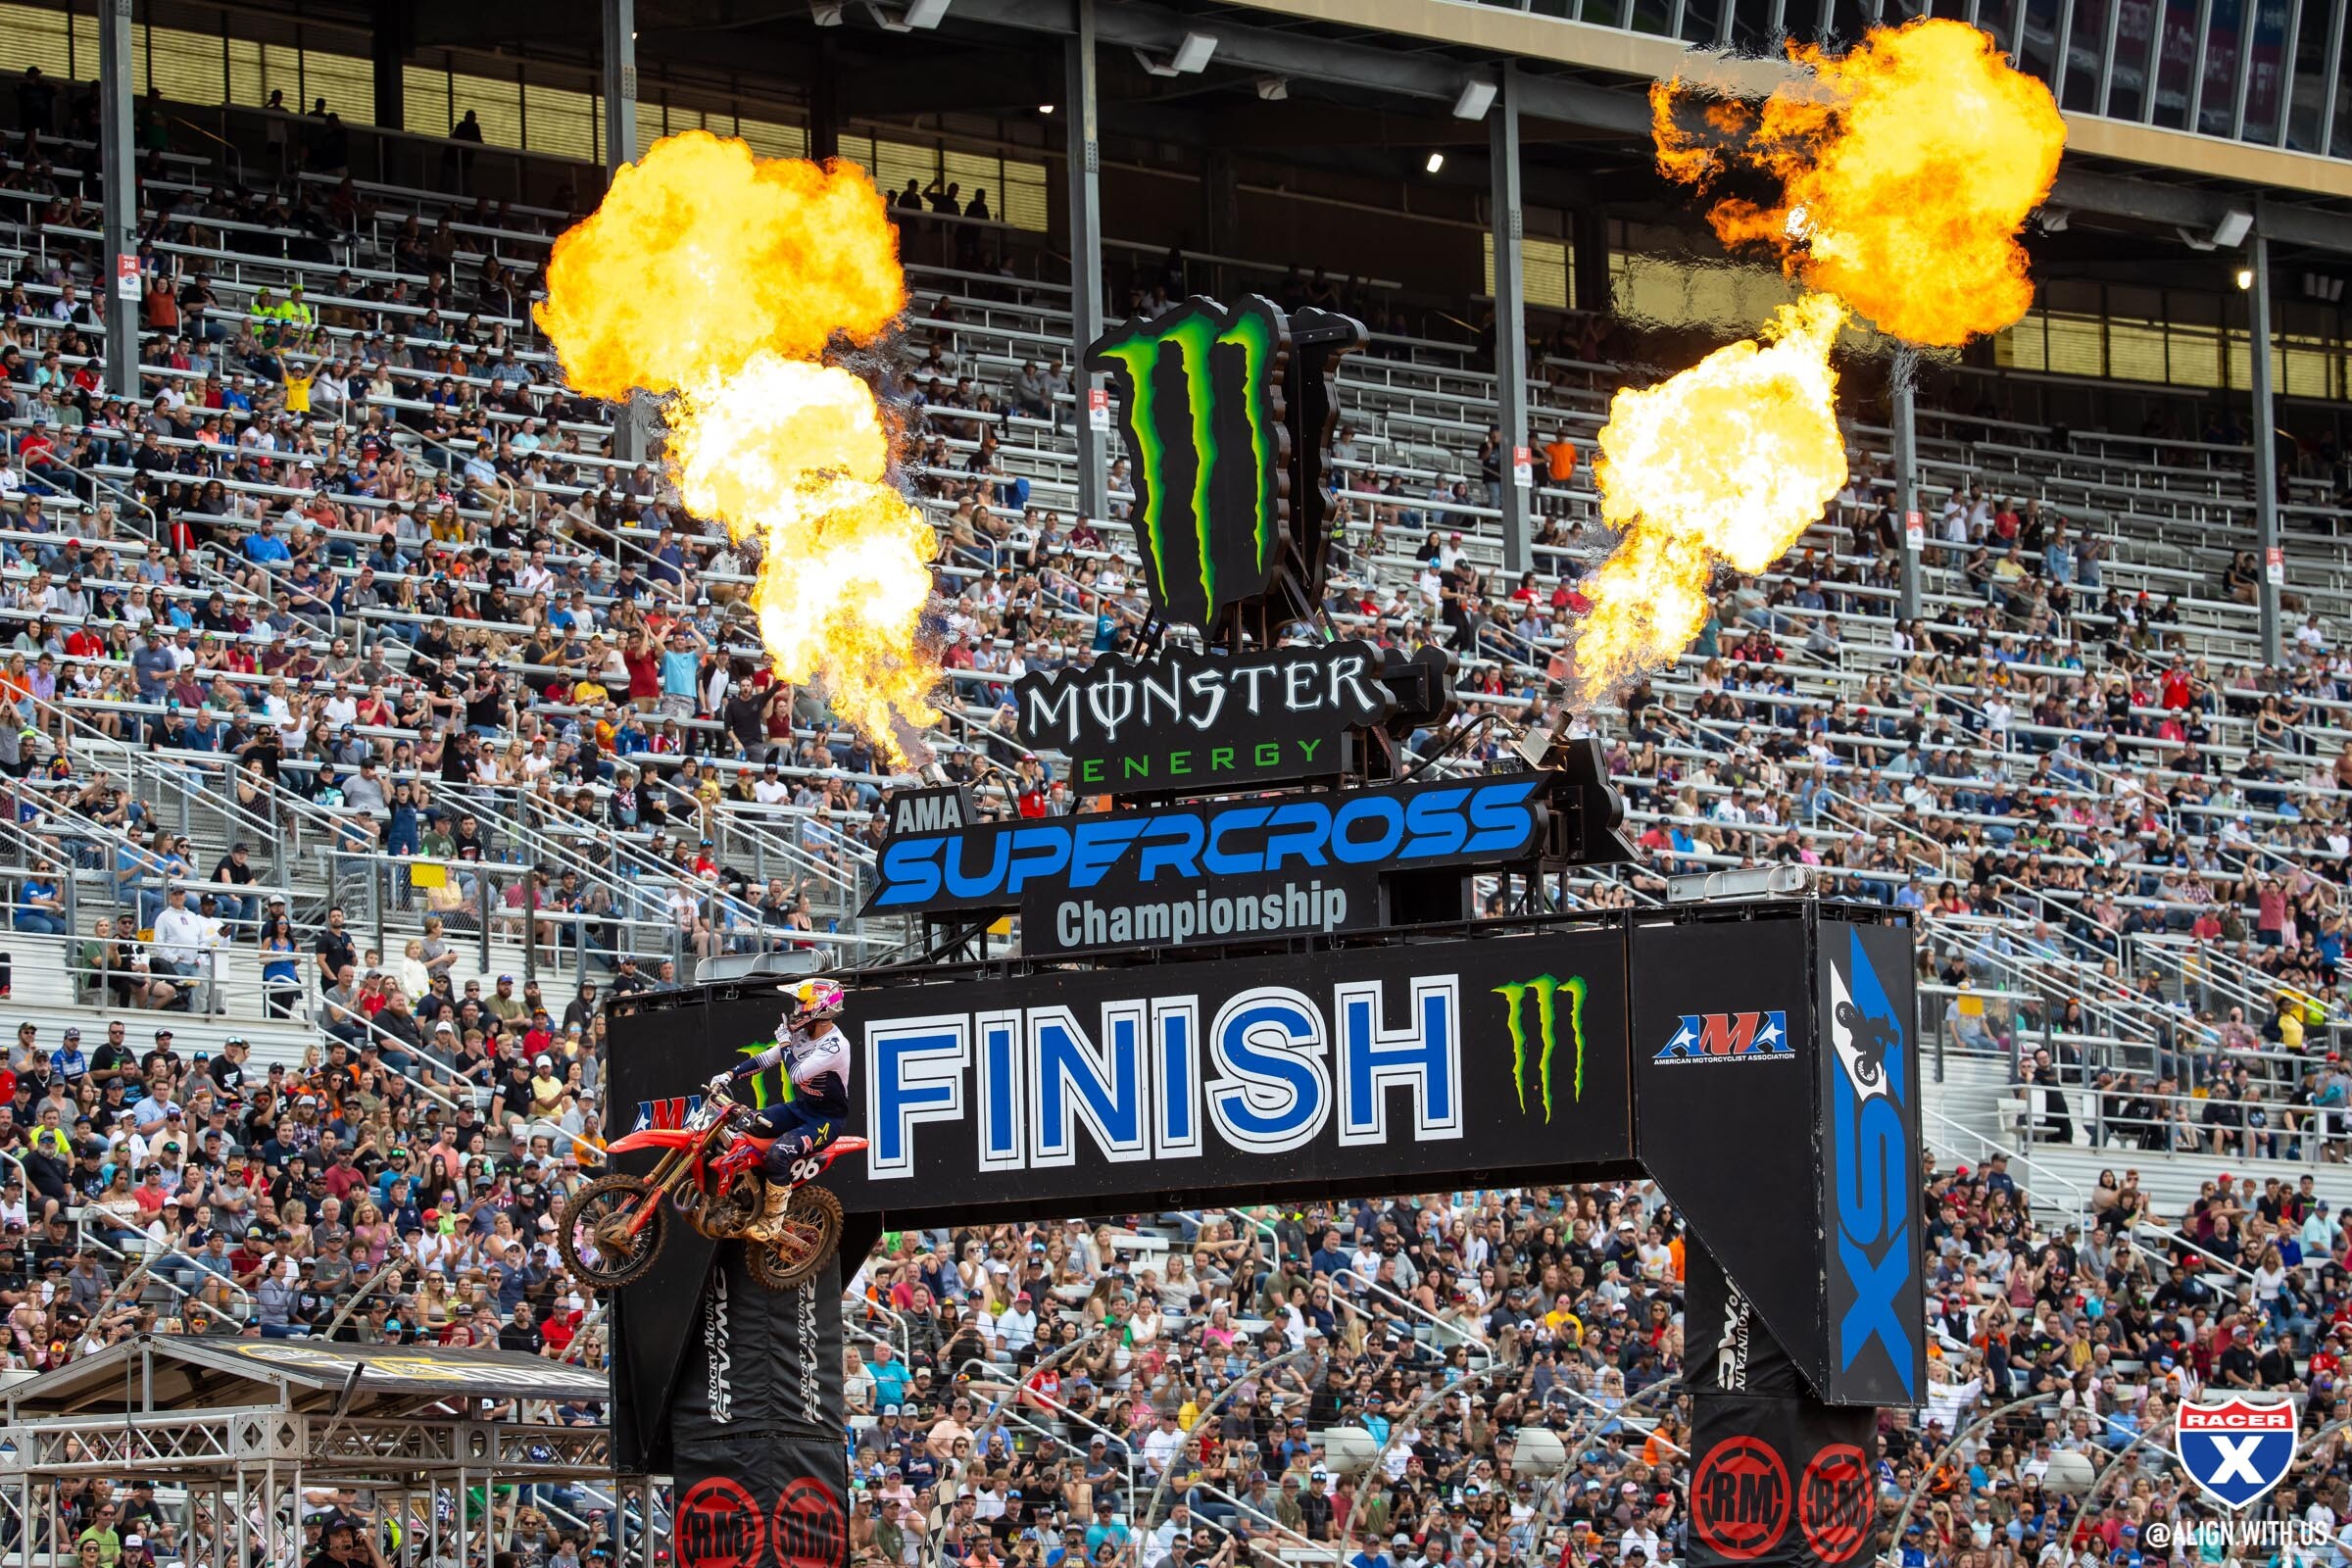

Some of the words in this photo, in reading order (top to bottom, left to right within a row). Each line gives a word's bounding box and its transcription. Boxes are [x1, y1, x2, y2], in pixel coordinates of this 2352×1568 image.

[1027, 655, 1375, 742] MONSTER
[1083, 738, 1322, 783] ENERGY
[895, 795, 961, 835] AMA
[875, 782, 1539, 906] SUPERCROSS
[1055, 879, 1348, 948] Championship
[1652, 1010, 1796, 1058] AMA
[1691, 1055, 1746, 1064] MOTORCYCLIST
[1747, 1053, 1795, 1061] ASSOCIATION
[864, 973, 1463, 1181] FINISH
[790, 1158, 820, 1182] 96
[797, 1280, 808, 1349] MOUNTA
[707, 1349, 721, 1402] ROCKY
[799, 1349, 811, 1401] ROCKY
[1715, 1471, 1772, 1524] RM
[1815, 1478, 1864, 1528] RM
[692, 1511, 745, 1559] RM
